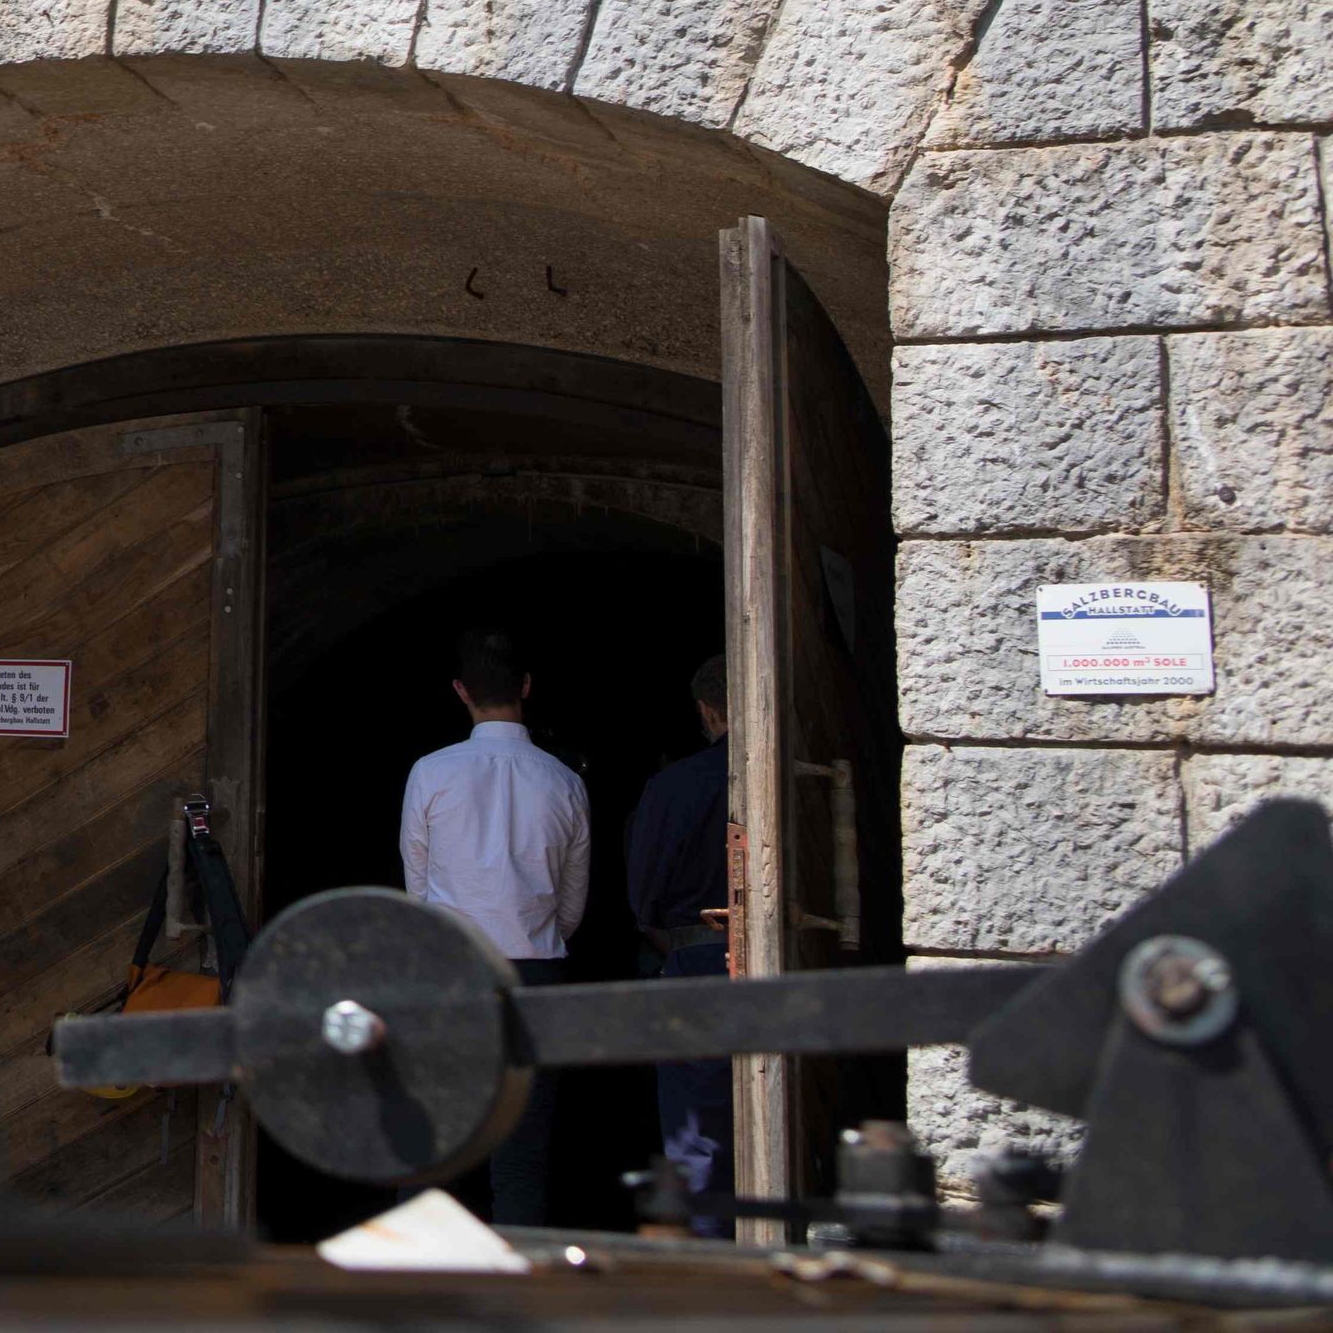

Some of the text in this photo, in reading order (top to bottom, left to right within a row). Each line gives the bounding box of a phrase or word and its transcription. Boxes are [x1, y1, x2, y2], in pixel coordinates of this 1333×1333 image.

[1088, 605, 1155, 615] HALLSTATT
[1062, 658, 1130, 668] 1.000.000
[1153, 657, 1187, 667] SOLE
[18, 670, 32, 679] des
[17, 681, 28, 690] ist
[29, 681, 40, 691] für
[1059, 676, 1194, 687] im Wirtschaftsjahr 2000
[11, 692, 17, 704] §
[36, 693, 49, 703] der
[23, 705, 55, 714] verboten
[25, 716, 51, 725] Hallstatt
